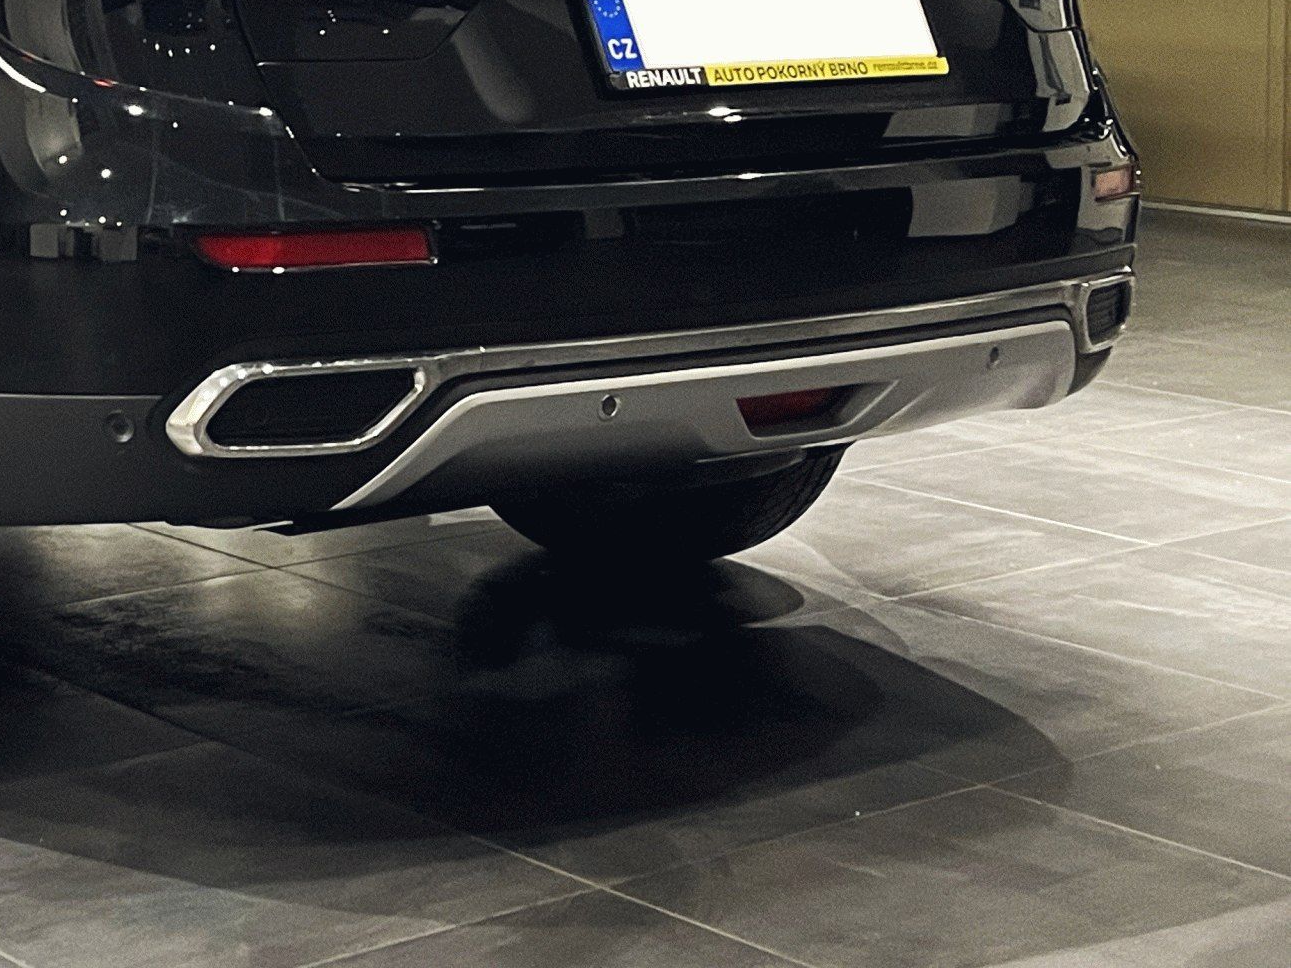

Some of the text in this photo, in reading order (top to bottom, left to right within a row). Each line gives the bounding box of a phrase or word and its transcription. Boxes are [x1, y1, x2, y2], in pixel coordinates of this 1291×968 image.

[607, 38, 638, 60] CZ
[625, 67, 702, 88] RENAULT
[714, 66, 755, 83] AUTO
[829, 61, 869, 77] BRNO
